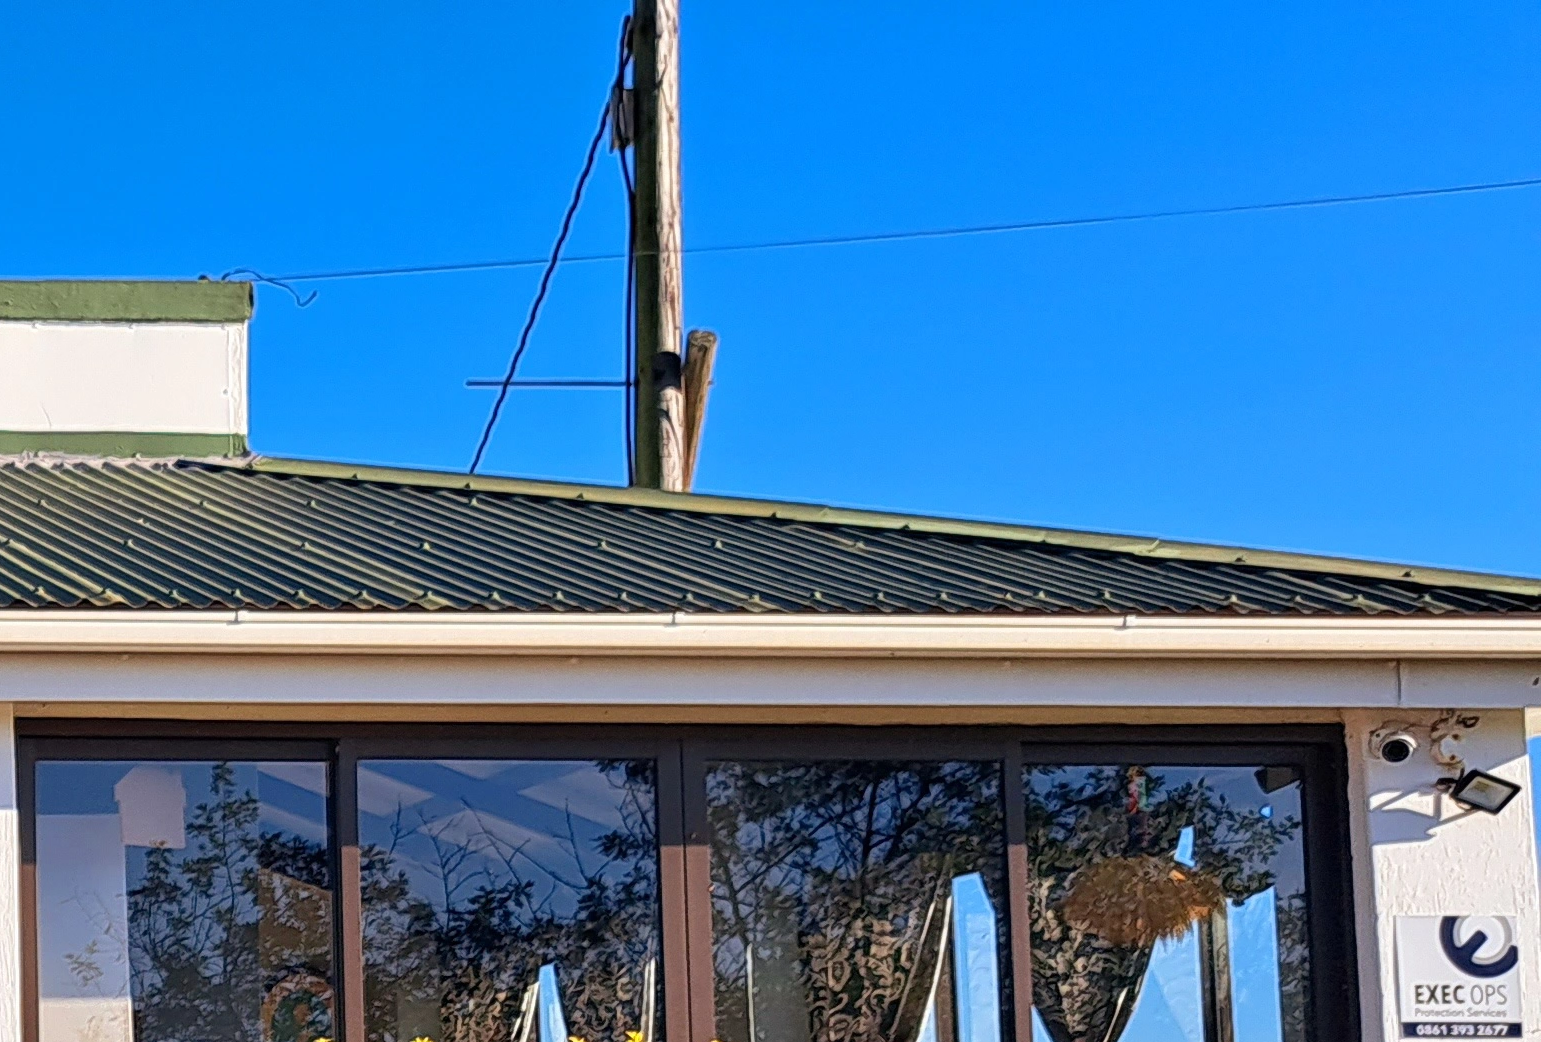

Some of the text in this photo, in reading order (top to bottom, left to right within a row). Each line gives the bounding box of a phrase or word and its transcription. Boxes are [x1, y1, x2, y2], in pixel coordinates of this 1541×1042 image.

[1414, 984, 1507, 1005] EXEC OPS
[1414, 1007, 1507, 1017] Protection Services
[1416, 1025, 1508, 1035] 0861 393 2677
